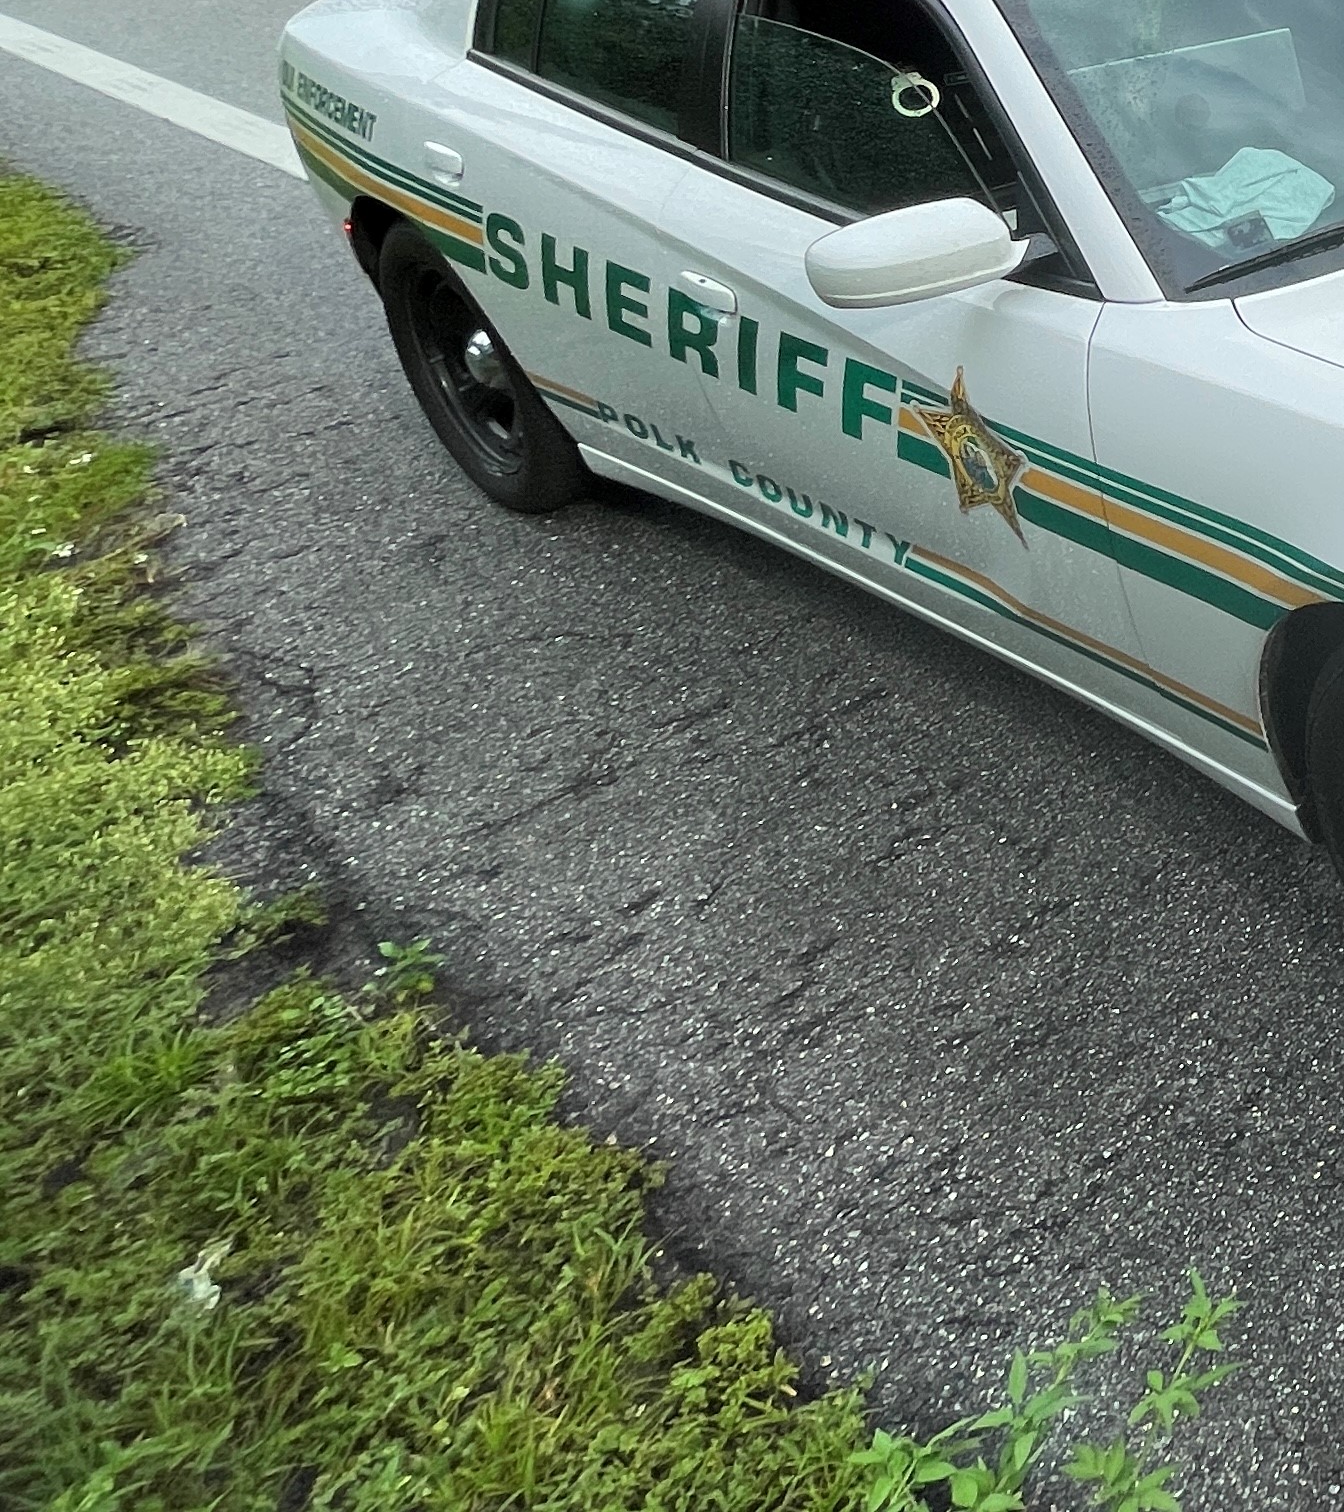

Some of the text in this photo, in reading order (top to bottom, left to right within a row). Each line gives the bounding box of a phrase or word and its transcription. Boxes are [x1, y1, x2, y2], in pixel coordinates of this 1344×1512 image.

[297, 72, 377, 142] ENFORCEMENT
[486, 212, 898, 440] SHERIFF
[597, 400, 702, 465] POLK
[728, 459, 910, 565] COUNTY
